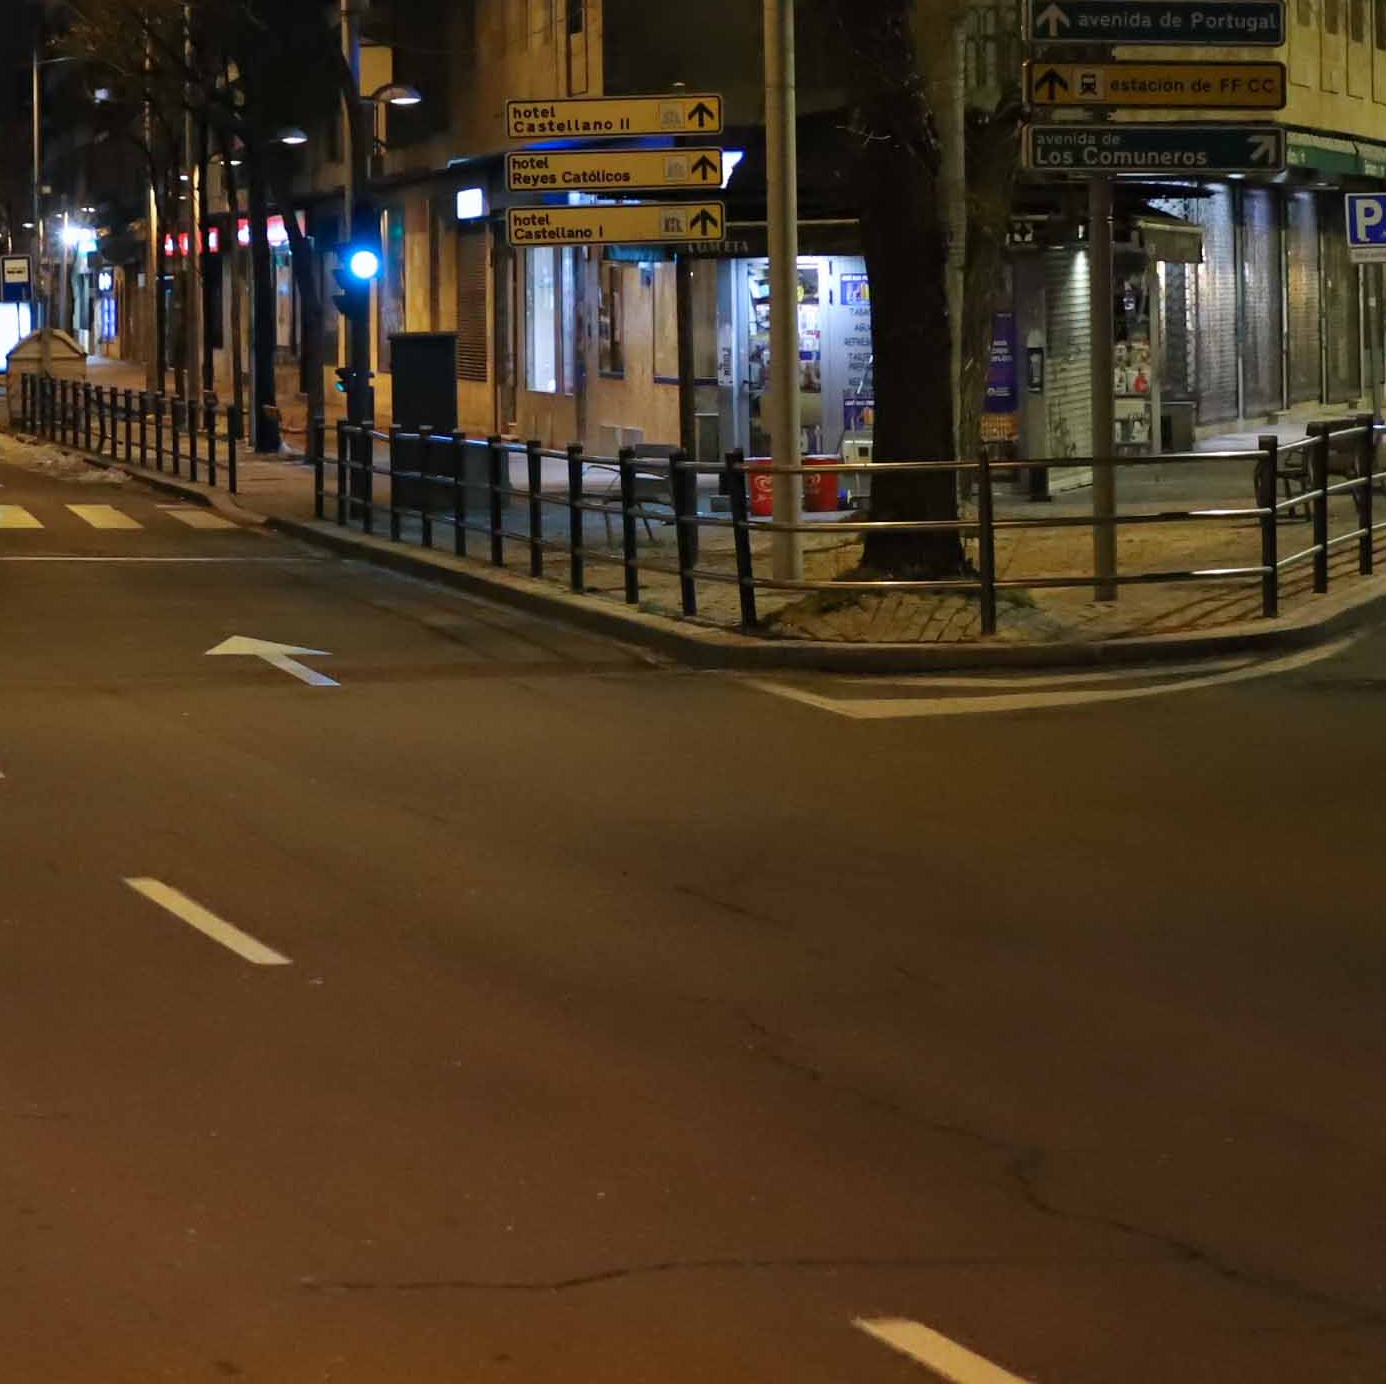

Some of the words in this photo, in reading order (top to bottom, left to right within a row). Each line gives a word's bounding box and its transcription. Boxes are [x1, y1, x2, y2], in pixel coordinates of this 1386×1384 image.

[1078, 12, 1152, 28] avenida
[1159, 12, 1183, 28] de
[1191, 11, 1278, 32] Portugal
[1191, 78, 1211, 93] de
[513, 104, 555, 119] hotel
[513, 118, 613, 133] Castellano
[619, 118, 630, 131] II
[1036, 133, 1096, 145] avenida
[1102, 133, 1121, 145] de
[512, 157, 549, 170] hotel
[1036, 148, 1074, 166] Los
[1083, 147, 1208, 166] Comuneros
[513, 171, 557, 187] Reyes
[561, 168, 631, 184] Católicos
[513, 213, 550, 226] hotel
[1355, 198, 1384, 243] P
[513, 226, 593, 241] Castellano
[598, 225, 603, 238] I
